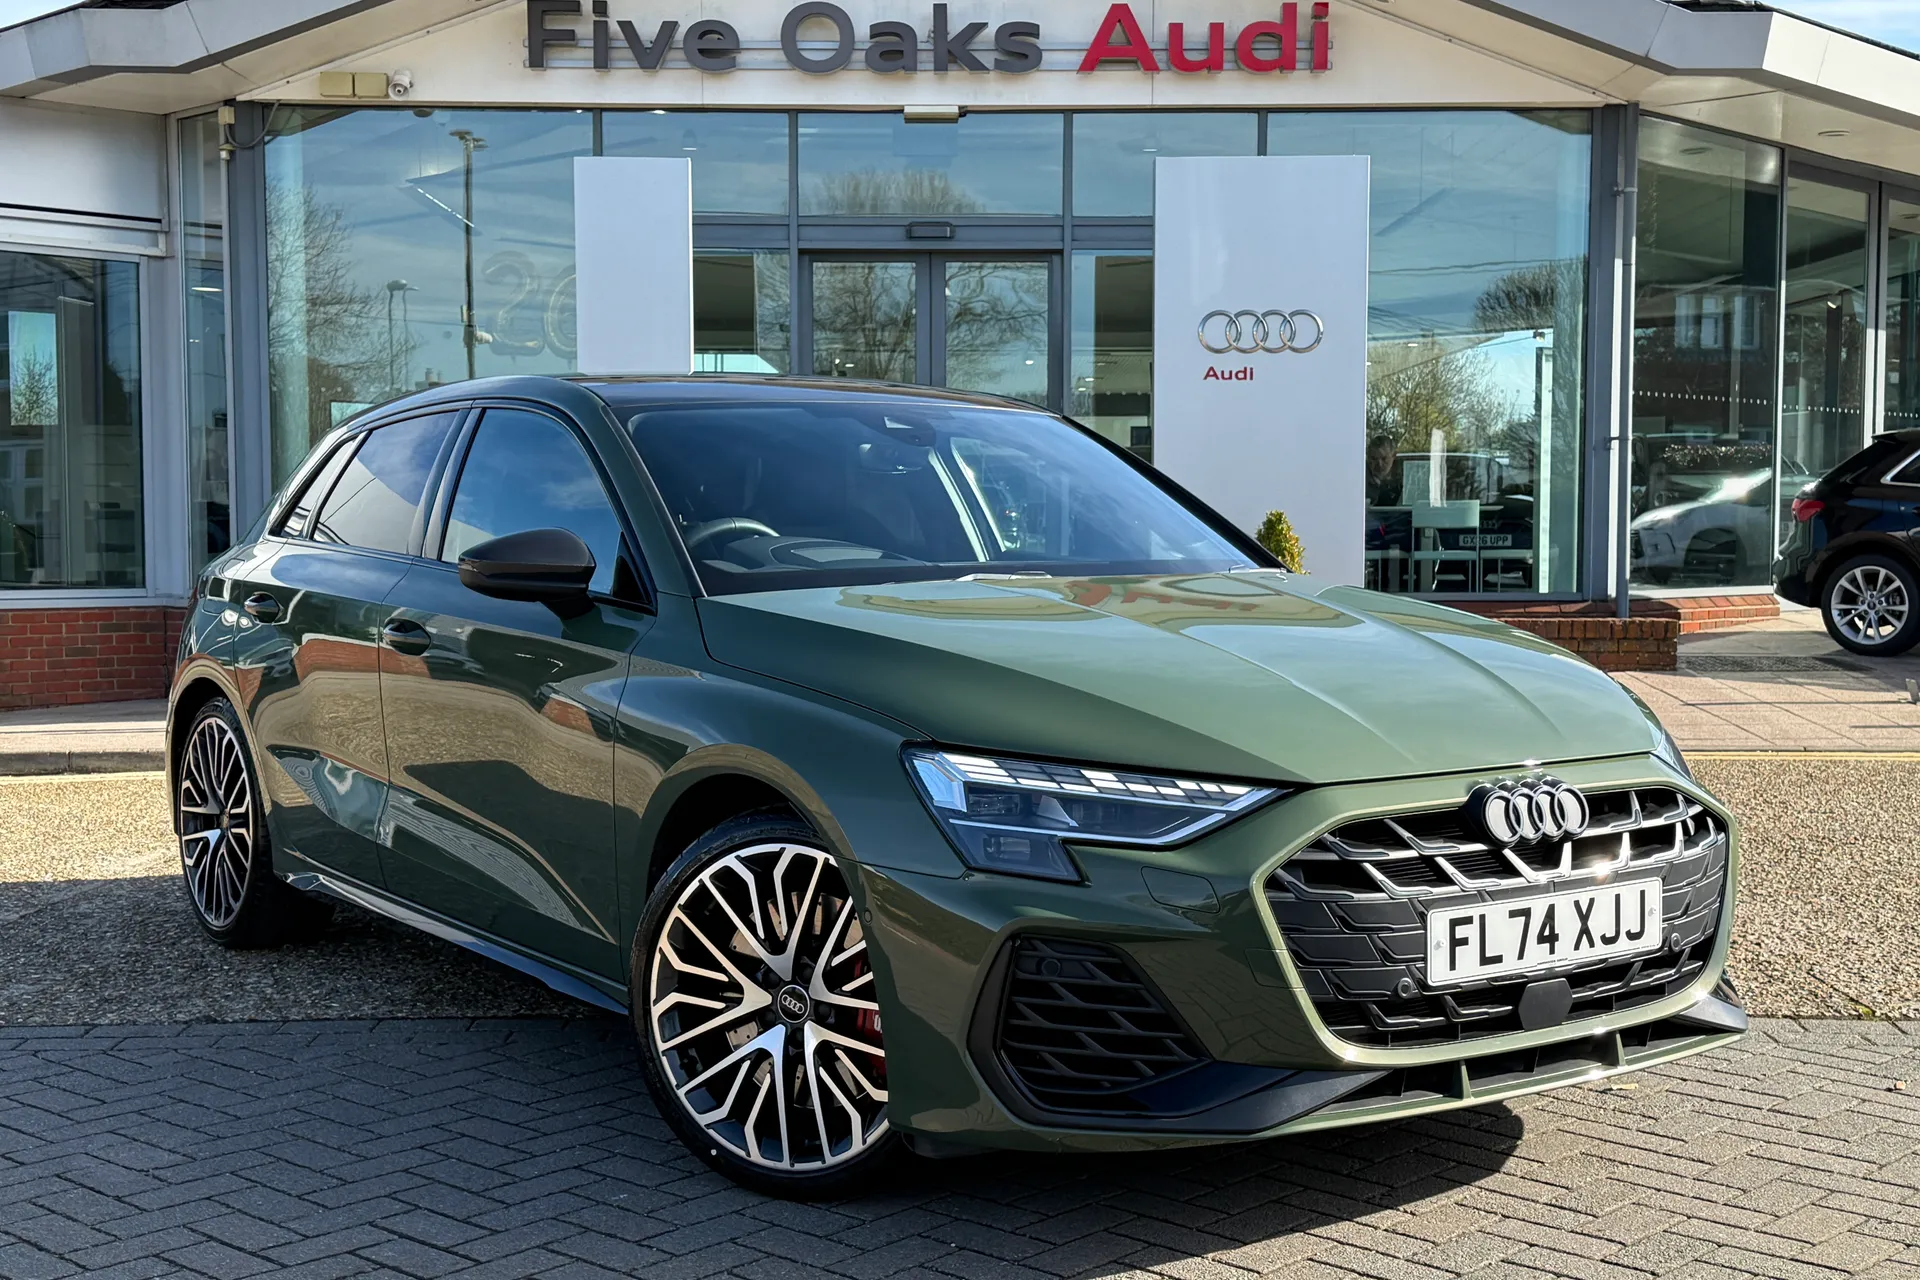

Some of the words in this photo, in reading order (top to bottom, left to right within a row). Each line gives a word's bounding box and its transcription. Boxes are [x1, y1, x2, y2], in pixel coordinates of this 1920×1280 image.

[527, 0, 742, 73] Five
[781, 1, 1043, 75] Oaks
[1076, 2, 1330, 75] Audi
[1203, 366, 1254, 381] Audi
[1489, 535, 1509, 545] UPP
[1449, 903, 1560, 972] FL74
[1573, 889, 1646, 951] XJJ
